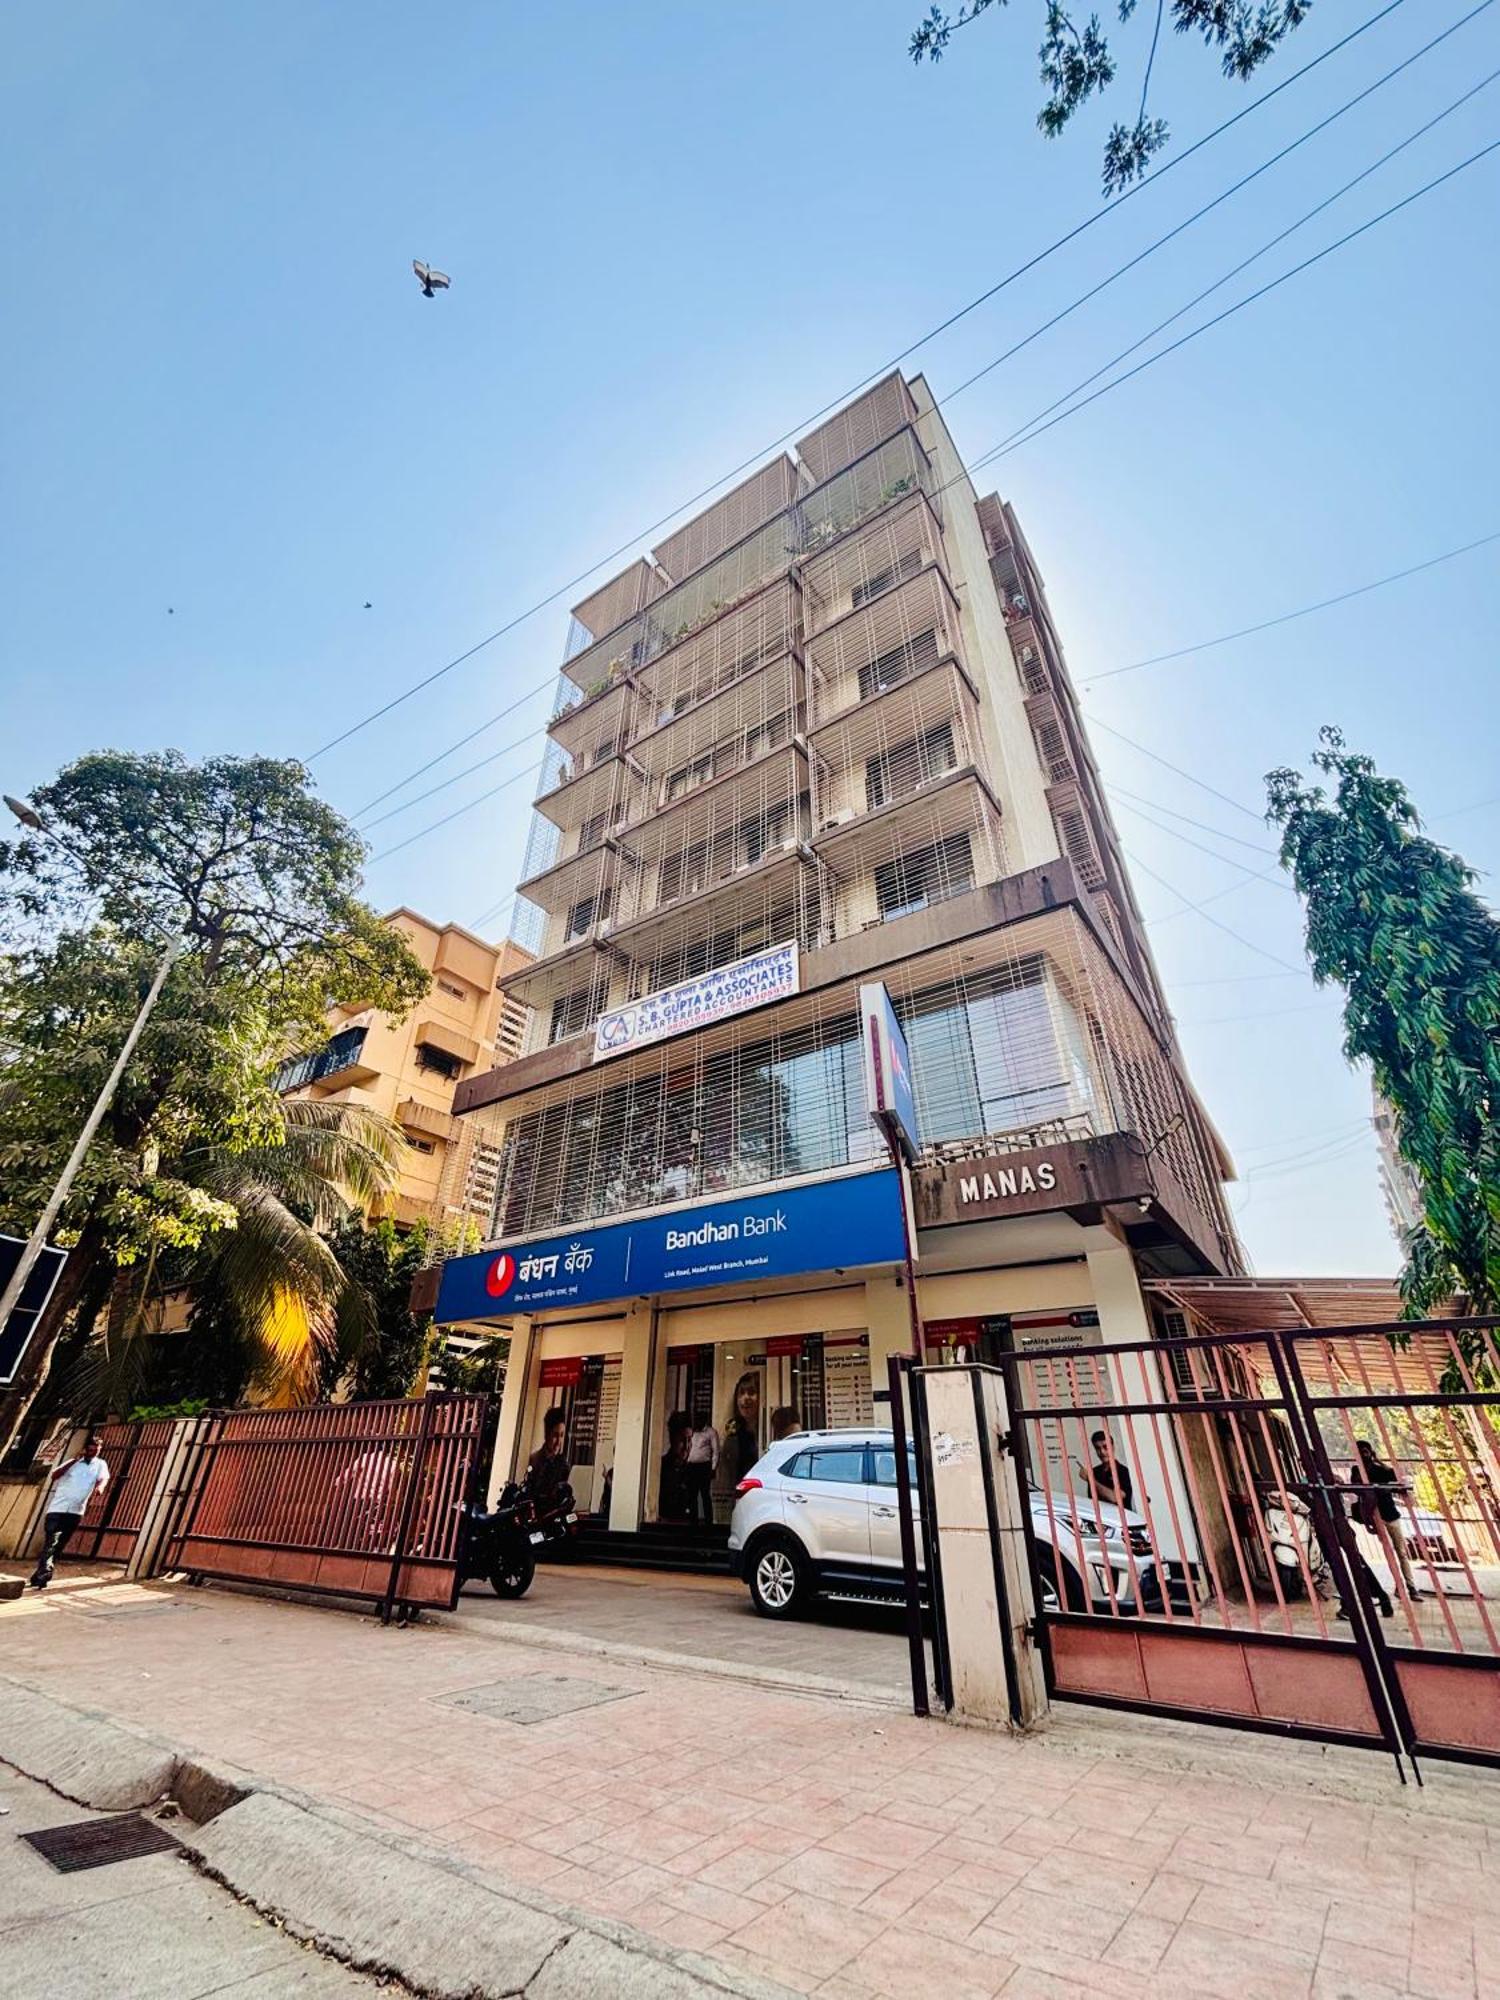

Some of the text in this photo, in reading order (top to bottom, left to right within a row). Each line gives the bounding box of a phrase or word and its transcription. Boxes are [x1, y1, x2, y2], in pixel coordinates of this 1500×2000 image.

[638, 974, 793, 1035] CHARTERED ACCOUNTANTS
[639, 961, 793, 1026] S. B. GUPTA & ASSOCIATES
[604, 1036, 627, 1048] INDIA
[960, 1162, 1056, 1204] MANAS
[666, 1208, 788, 1251] Bandhan Bank
[519, 1242, 595, 1282] बंधन बँक
[708, 1262, 722, 1271] West
[723, 1259, 745, 1270] Branch,
[745, 1255, 769, 1266] Mumbai
[1050, 1335, 1083, 1343] solutions
